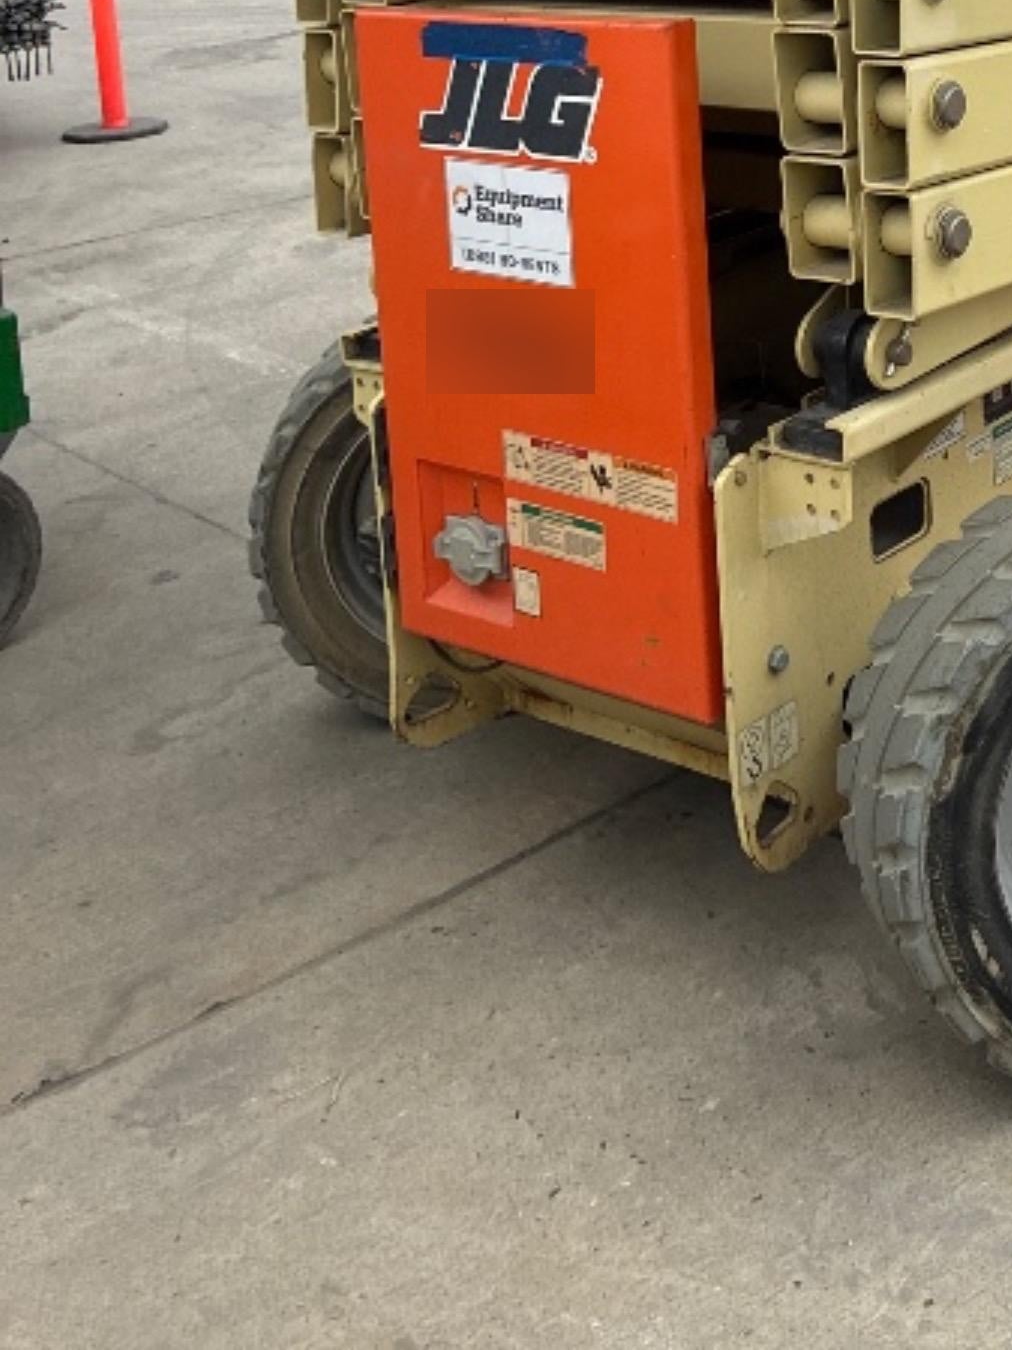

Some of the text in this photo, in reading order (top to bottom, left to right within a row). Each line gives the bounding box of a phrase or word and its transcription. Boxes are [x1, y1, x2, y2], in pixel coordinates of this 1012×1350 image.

[419, 58, 603, 163] JLG
[475, 184, 563, 212] Equipment
[476, 205, 523, 228] Share
